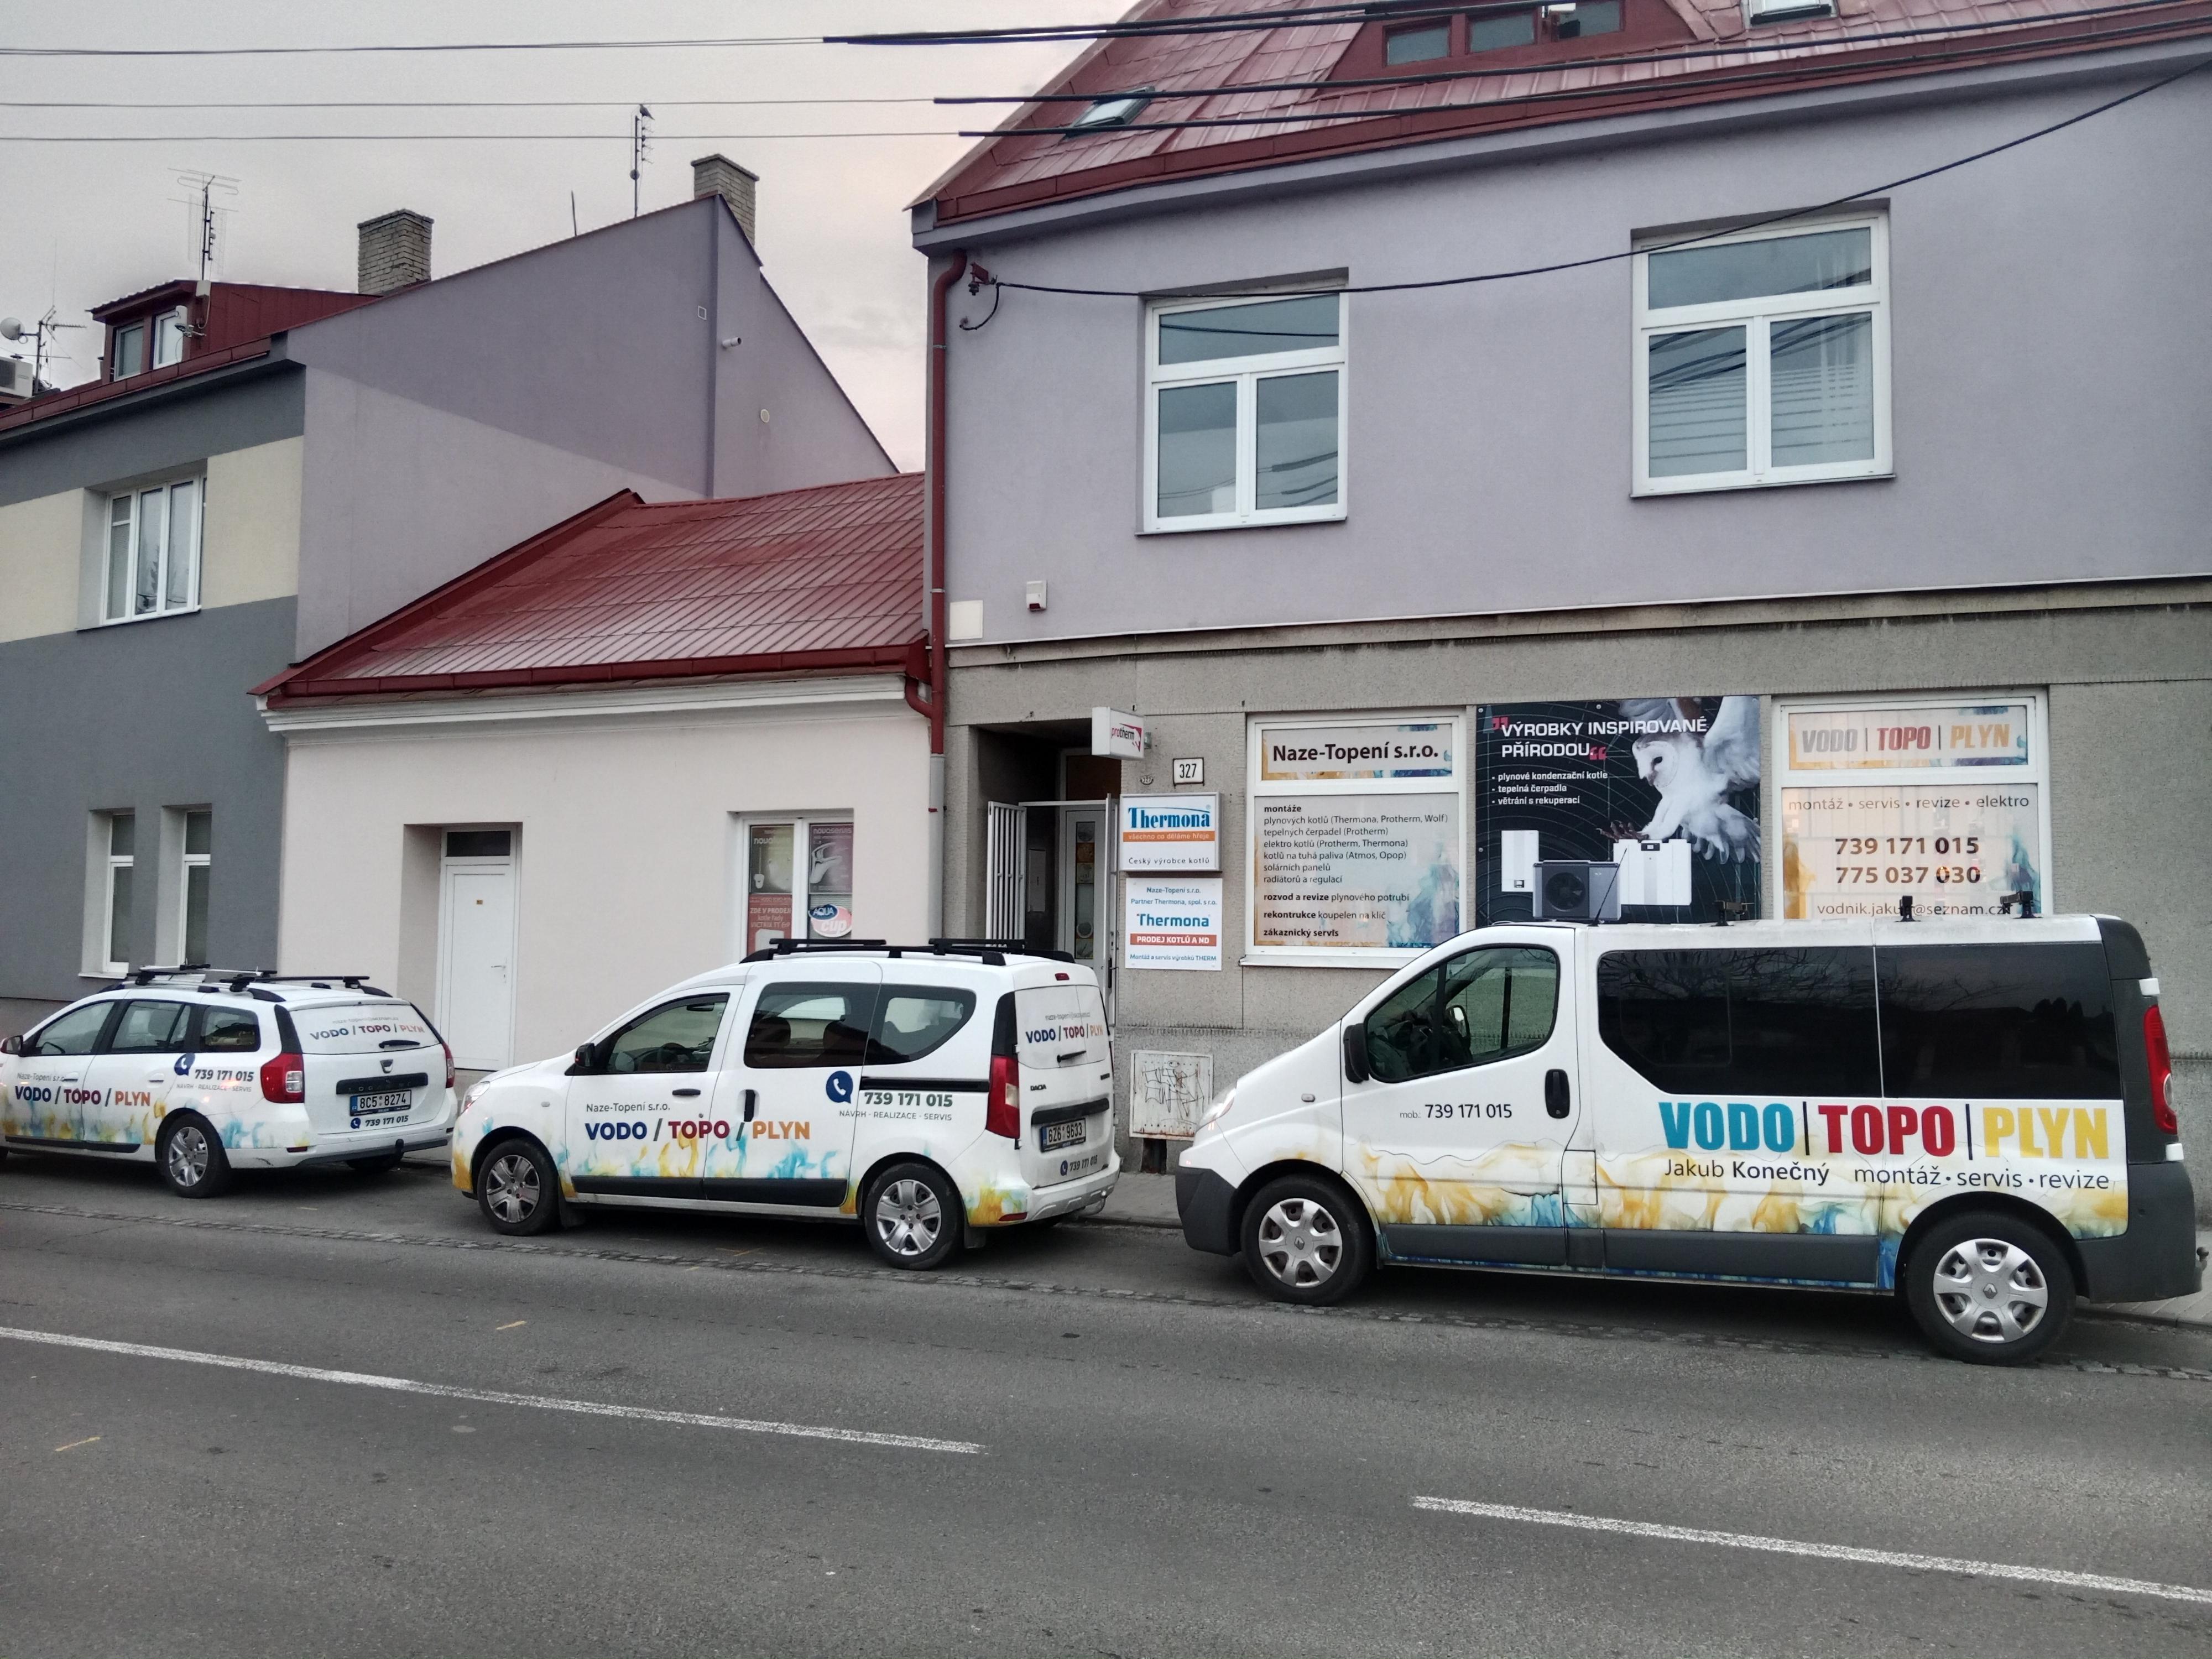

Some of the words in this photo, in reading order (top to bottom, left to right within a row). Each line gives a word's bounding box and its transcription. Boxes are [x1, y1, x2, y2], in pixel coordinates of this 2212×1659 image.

[1111, 727, 1135, 740] protherm
[1502, 721, 1583, 737] VÝROBKY
[1588, 716, 1707, 735] INSPIROVANÉ
[1802, 728, 1858, 753] VODO
[1877, 726, 1931, 751] TOPO
[1950, 723, 2010, 749] PLYN
[1273, 743, 1389, 763] Naze-Topení
[1394, 743, 1438, 758] s.r.o.
[1179, 764, 1197, 778] 327
[1498, 773, 1530, 782] plynové
[1532, 771, 1585, 780] kondenzační
[1498, 785, 1528, 794] tepelná
[1531, 784, 1567, 794] čerpadla
[1536, 796, 1580, 805] rekuperací
[1789, 797, 1844, 811] montáž
[1859, 797, 1901, 810] servis
[1916, 796, 1960, 808] revize
[1976, 795, 2029, 807] elektro
[1128, 807, 1210, 828] Thermona
[1264, 816, 1305, 825] plynových
[1331, 815, 1379, 825] (Thermona,
[1381, 815, 1422, 823] Protherm,
[1425, 814, 1448, 823] Wolf)
[1264, 828, 1303, 837] tepelných
[1306, 828, 1341, 837] čerpadel
[1343, 827, 1388, 836] (Protherm)
[1363, 839, 1408, 847] Thermona)
[1835, 838, 1878, 854] 739
[1886, 838, 1925, 854] 171
[1935, 837, 1979, 854] 015
[1319, 852, 1343, 860] paliva
[1346, 852, 1378, 860] (Atmos,
[1379, 851, 1406, 860] Opop)
[1303, 864, 1331, 873] panelů
[1835, 867, 1878, 884] 775
[1886, 867, 1928, 884] 037
[1936, 866, 1980, 884] 030
[1310, 875, 1342, 884] regulací
[1332, 894, 1375, 902] plynového
[1378, 894, 1409, 902] potrubí
[813, 907, 834, 916] AQUA
[1817, 901, 2003, 917] vodnik.jaku@seznam.cz
[821, 920, 847, 935] cup
[1137, 914, 1209, 927] Thermona
[1167, 935, 1190, 943] KOTLŮ
[1264, 929, 1311, 937] zákaznický
[310, 1028, 348, 1040] VODO
[359, 1025, 391, 1033] TOPO
[1026, 1029, 1056, 1044] VODO
[1063, 1026, 1084, 1039] TOPO
[1090, 1025, 1103, 1036] PLYN
[195, 1070, 213, 1079] 739
[217, 1070, 233, 1080] 171
[236, 1071, 254, 1082] 015
[15, 1086, 51, 1102] VODO
[64, 1088, 101, 1104] TOPO
[115, 1091, 150, 1106] PLYN
[360, 1097, 377, 1109] 8C5
[384, 1093, 406, 1106] 8274
[864, 1092, 893, 1105] 739
[899, 1093, 920, 1106] 171
[926, 1094, 953, 1107] 015
[586, 1102, 645, 1113] Naze-Topení
[648, 1102, 670, 1111] s.r.o.
[1425, 1104, 1453, 1119] 739
[1458, 1103, 1481, 1118] 171
[1486, 1103, 1512, 1118] 015
[585, 1121, 647, 1140] VODO
[669, 1121, 729, 1139] TOPO
[753, 1121, 810, 1139] PLYN
[1048, 1127, 1061, 1142] 6Z6
[1067, 1123, 1082, 1138] 9633
[1658, 1101, 1796, 1154] VODO
[1819, 1105, 1955, 1157] TOPO
[1983, 1107, 2109, 1160] PLYN
[1070, 1160, 1081, 1171] 739
[1664, 1159, 1725, 1178] Jakub
[1733, 1160, 1830, 1186] Konečný
[1854, 1164, 1941, 1186] montáž
[1957, 1169, 2022, 1188] servis
[2039, 1170, 2109, 1190] revize
